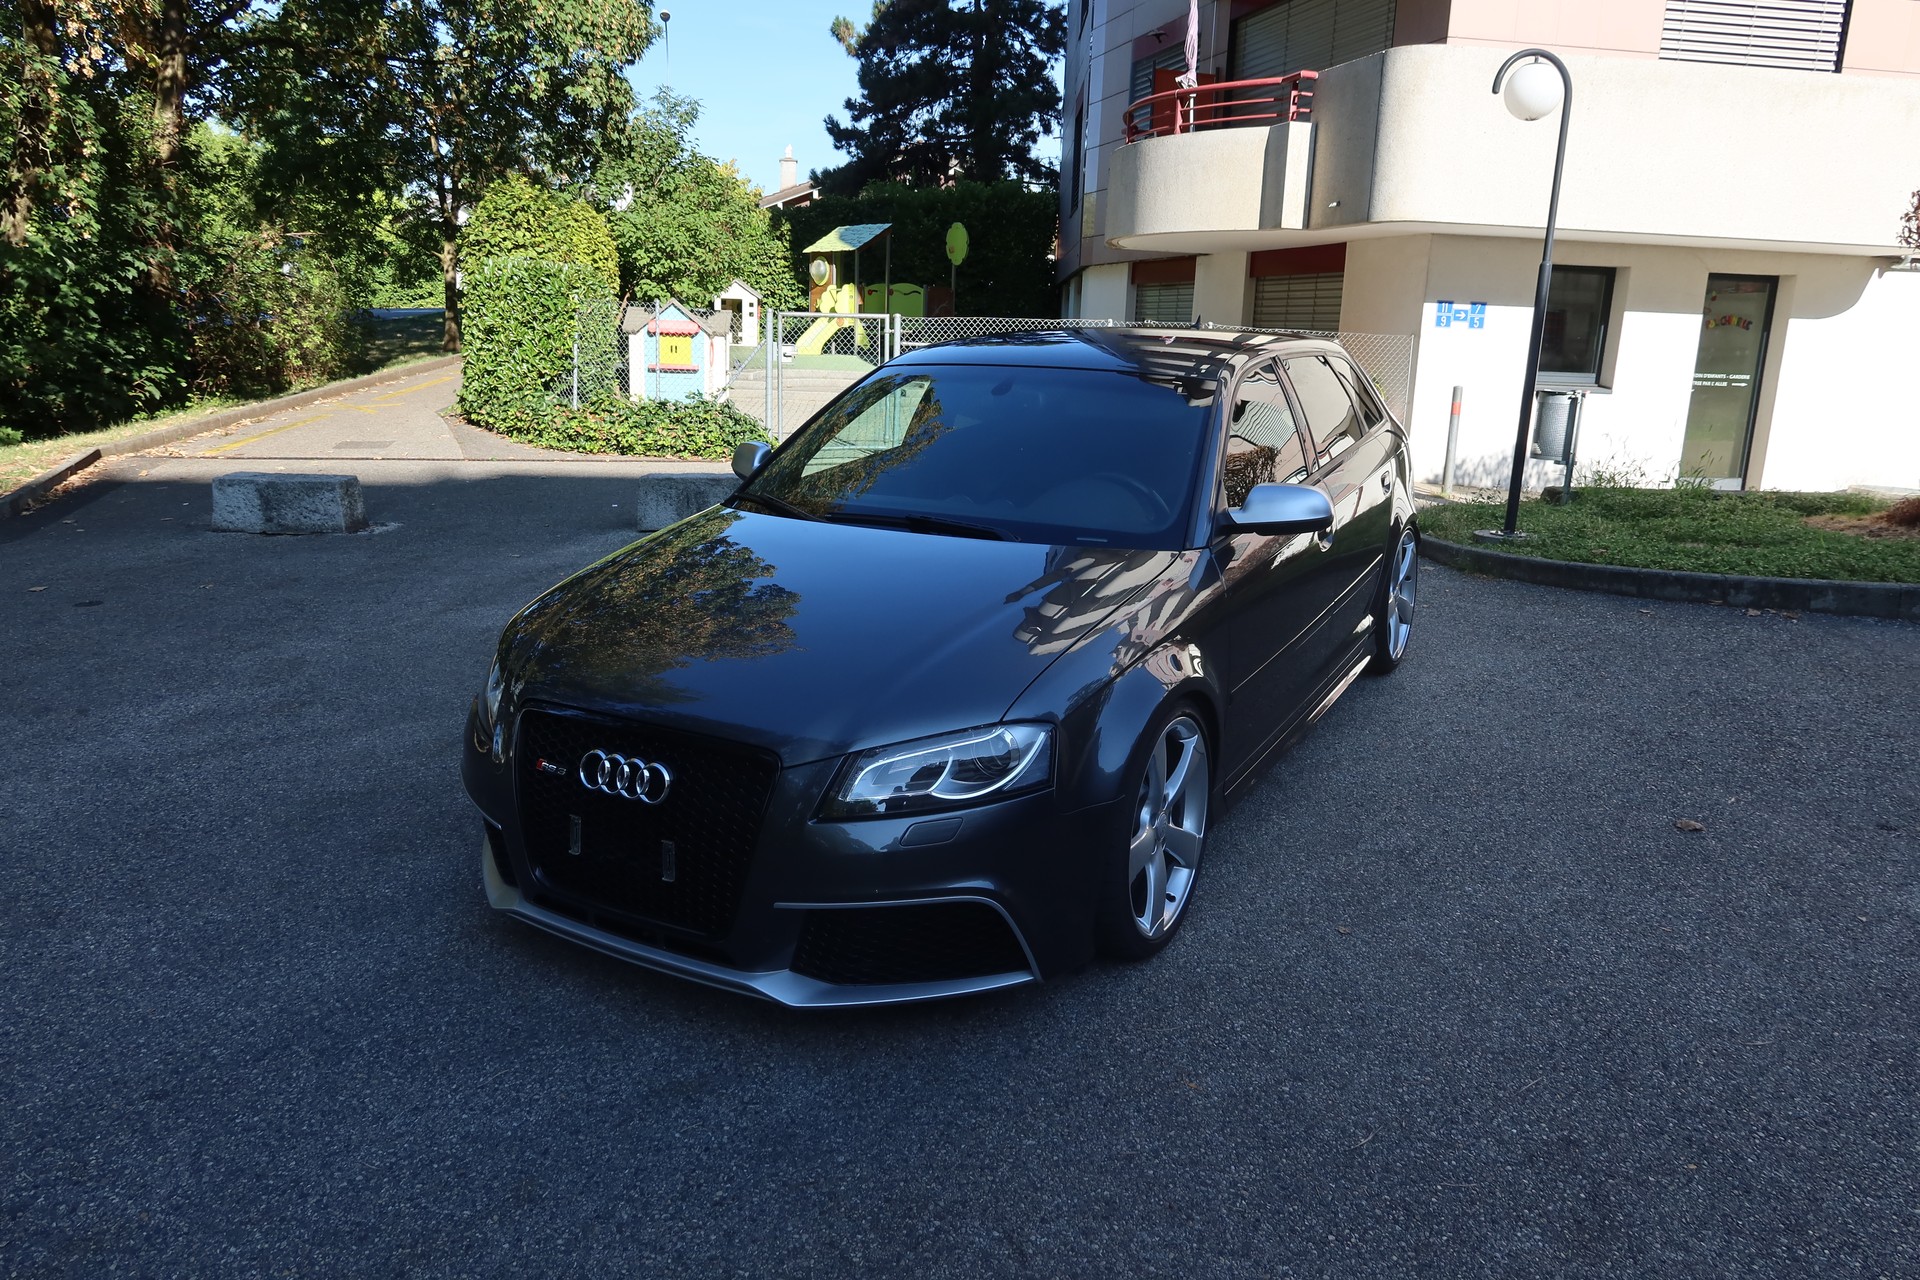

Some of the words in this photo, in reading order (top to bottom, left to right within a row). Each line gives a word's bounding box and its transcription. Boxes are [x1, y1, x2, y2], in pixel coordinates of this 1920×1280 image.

[1442, 302, 1448, 313] 11
[1476, 304, 1482, 314] 7
[1440, 316, 1446, 326] 9
[1474, 318, 1480, 328] 5
